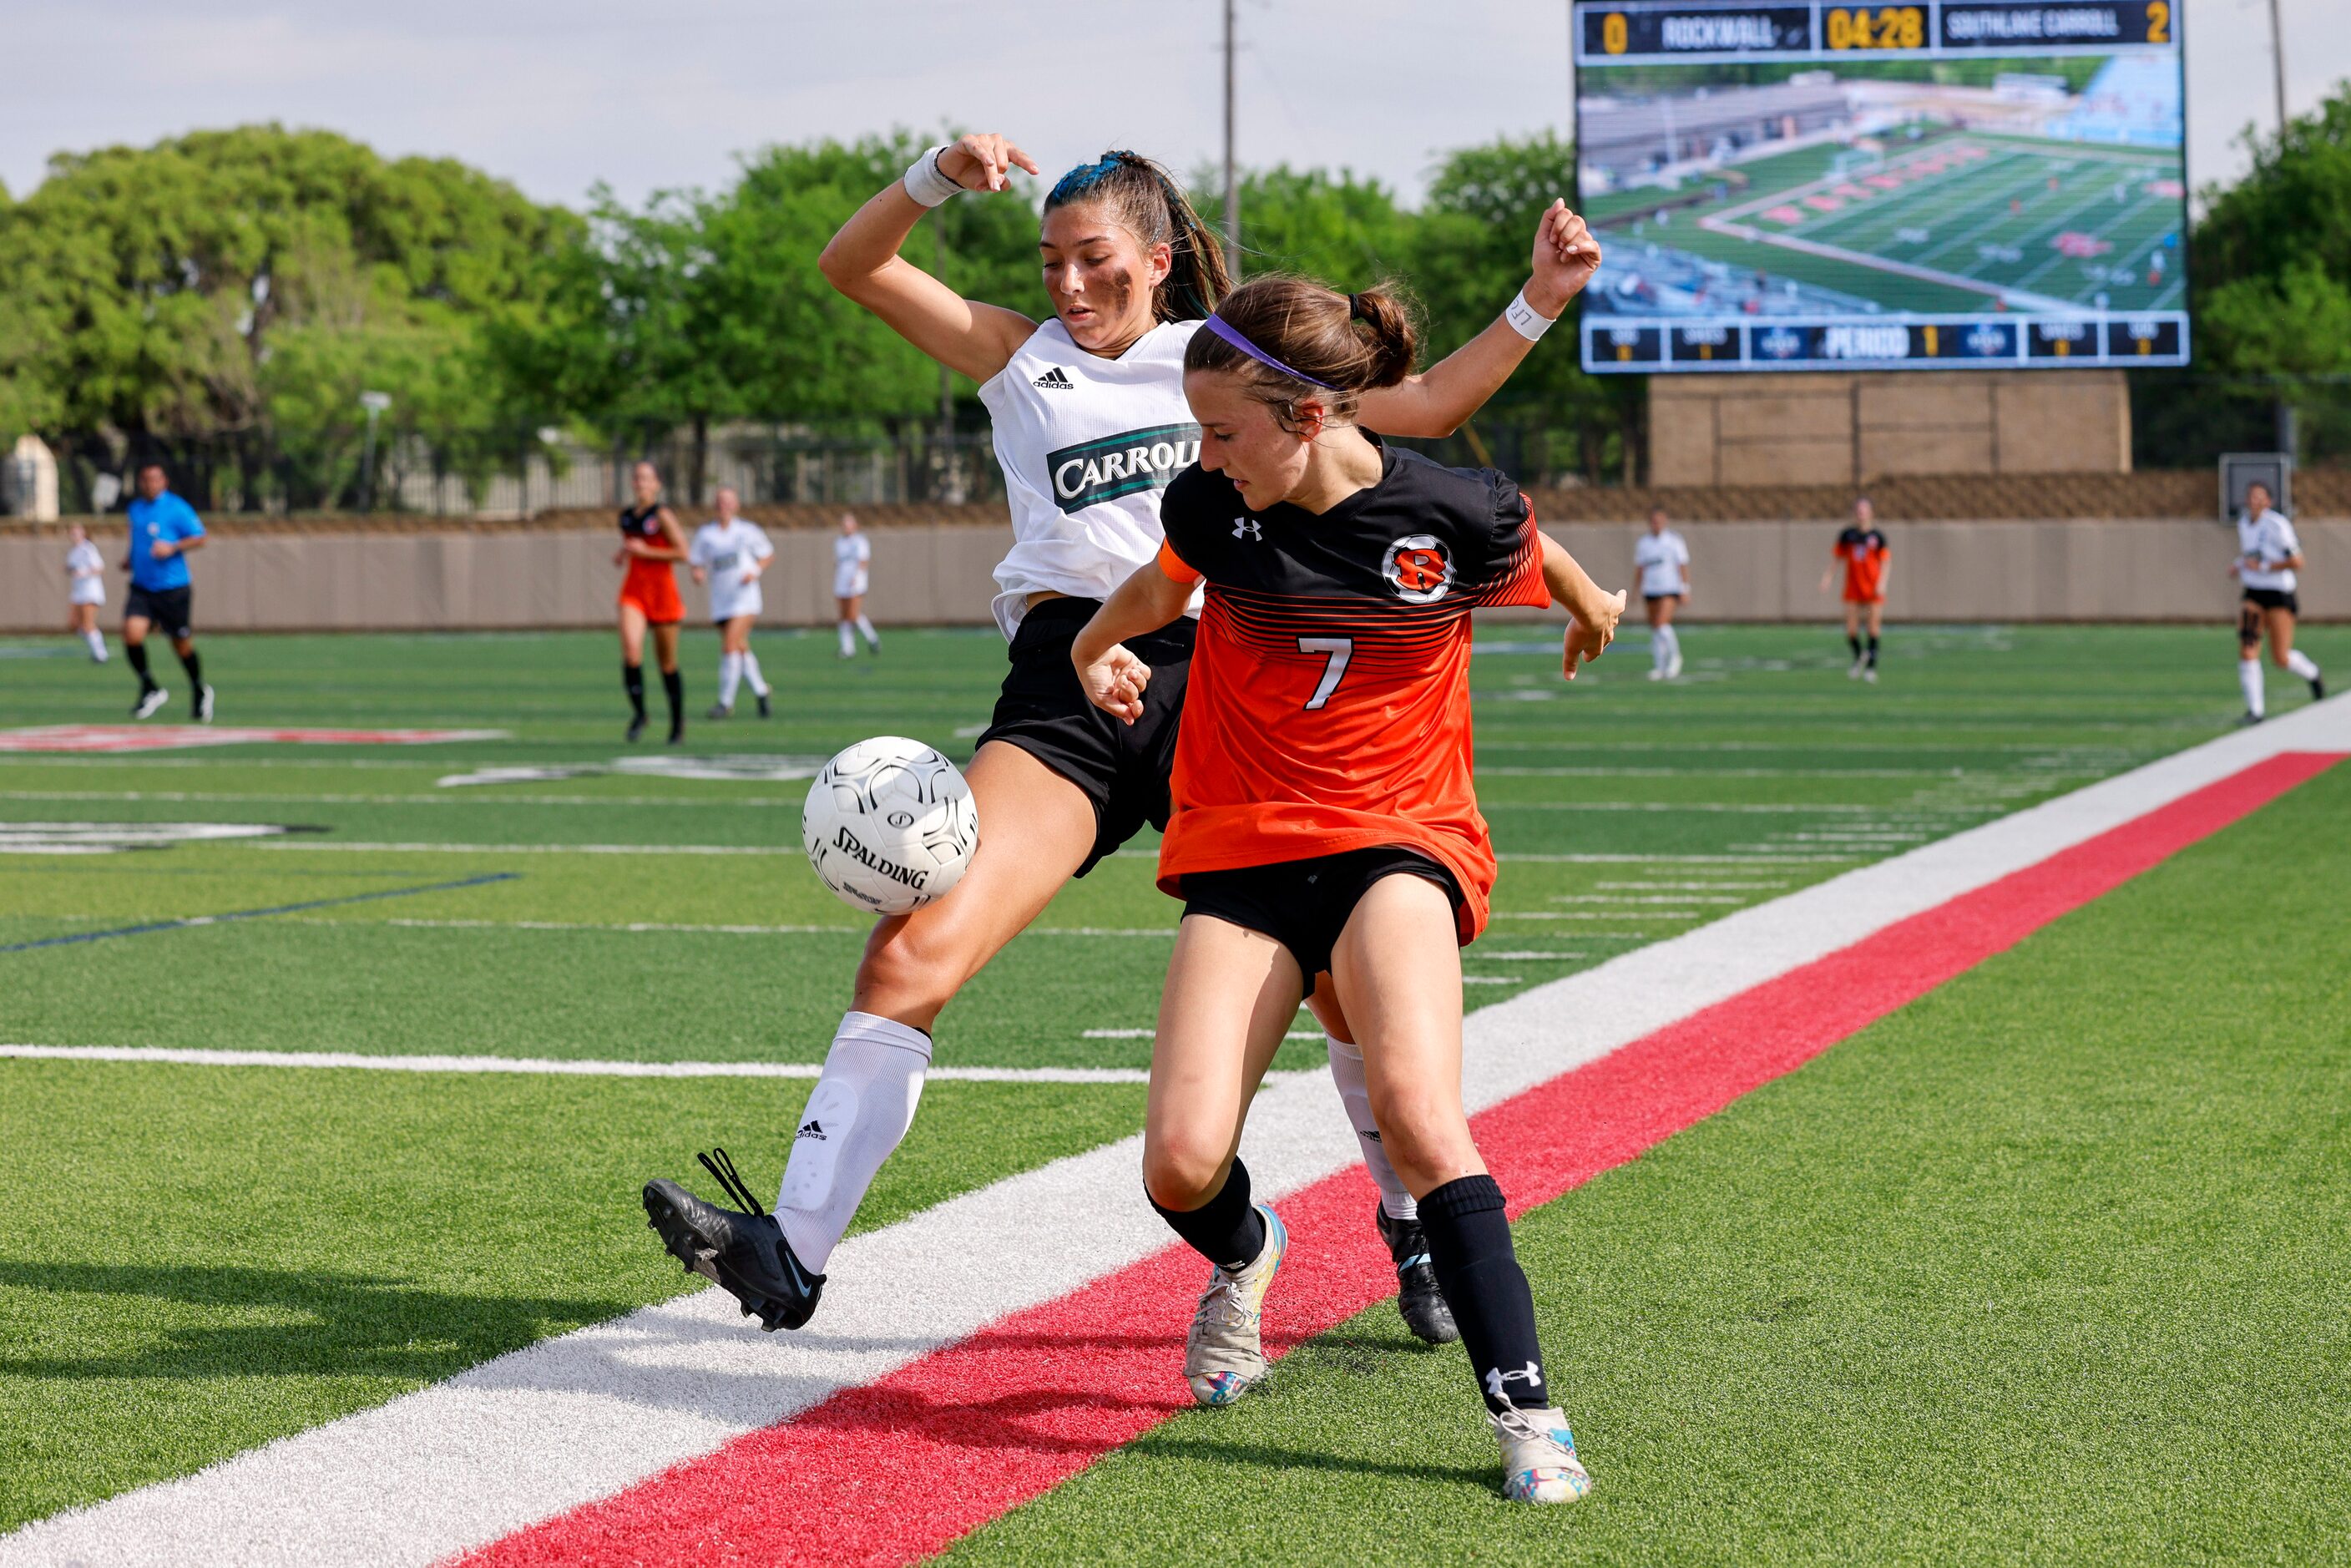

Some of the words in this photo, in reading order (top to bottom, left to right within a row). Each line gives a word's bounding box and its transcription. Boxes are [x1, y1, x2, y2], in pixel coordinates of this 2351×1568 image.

[1603, 13, 1628, 54] 0
[1828, 8, 1923, 48] 04:28
[2146, 1, 2169, 43] 2
[1033, 380, 1074, 390] adidas
[1297, 637, 1353, 711] 7
[833, 826, 928, 890] SPALDING
